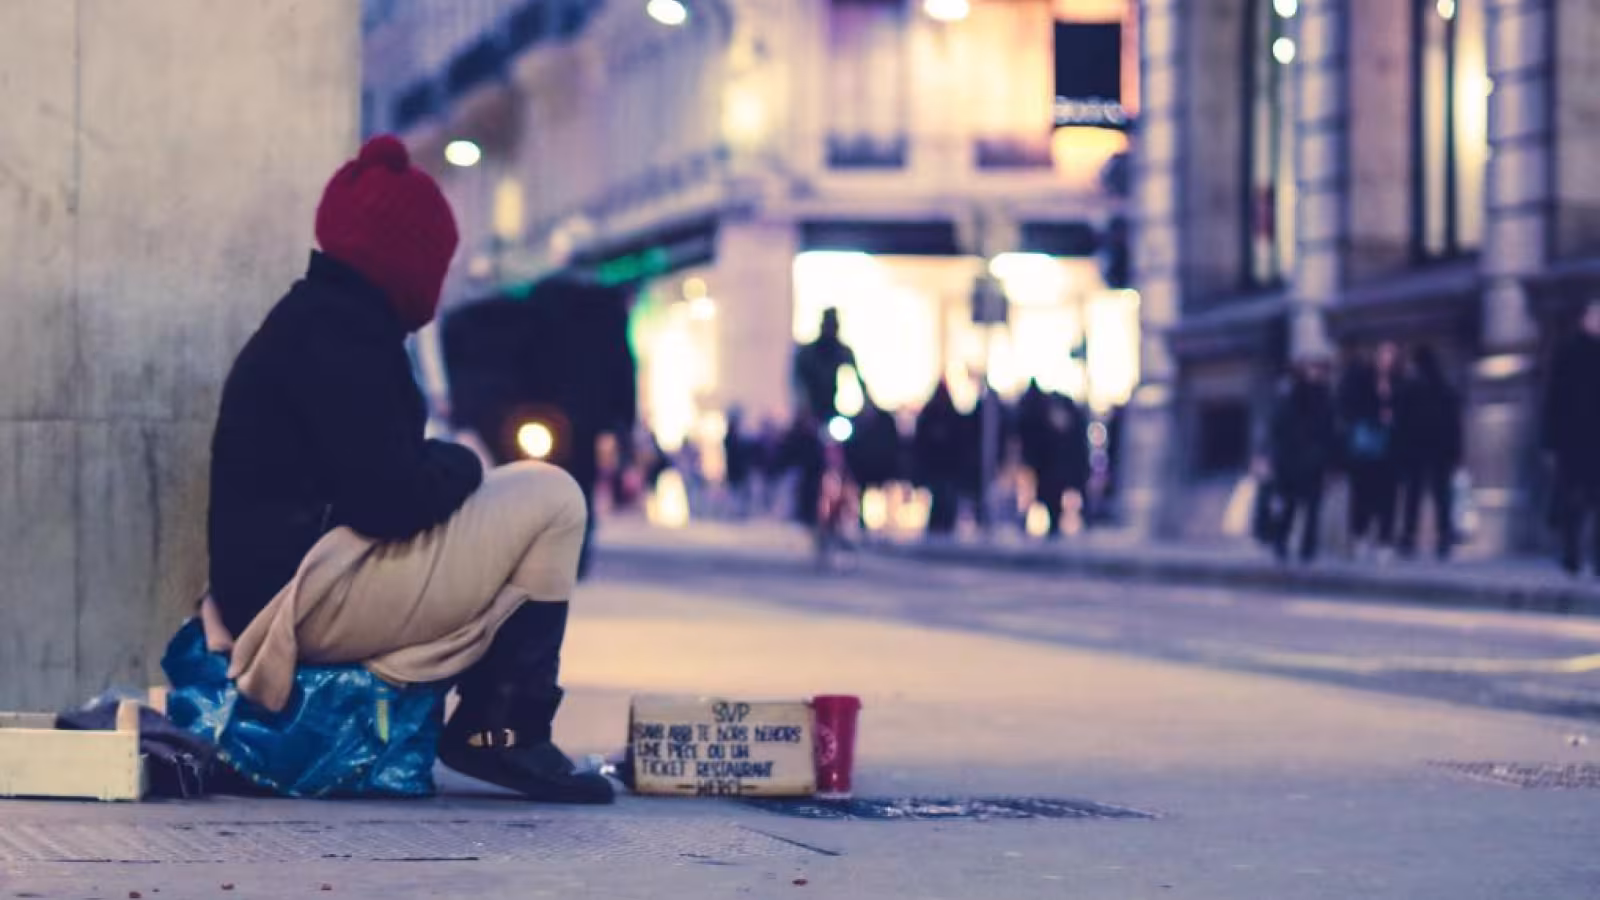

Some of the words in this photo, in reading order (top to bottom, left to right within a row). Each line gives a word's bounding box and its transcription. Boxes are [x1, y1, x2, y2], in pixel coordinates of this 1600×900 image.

[712, 701, 750, 722] SVP
[708, 743, 725, 759] OU
[642, 759, 685, 776] TICKET
